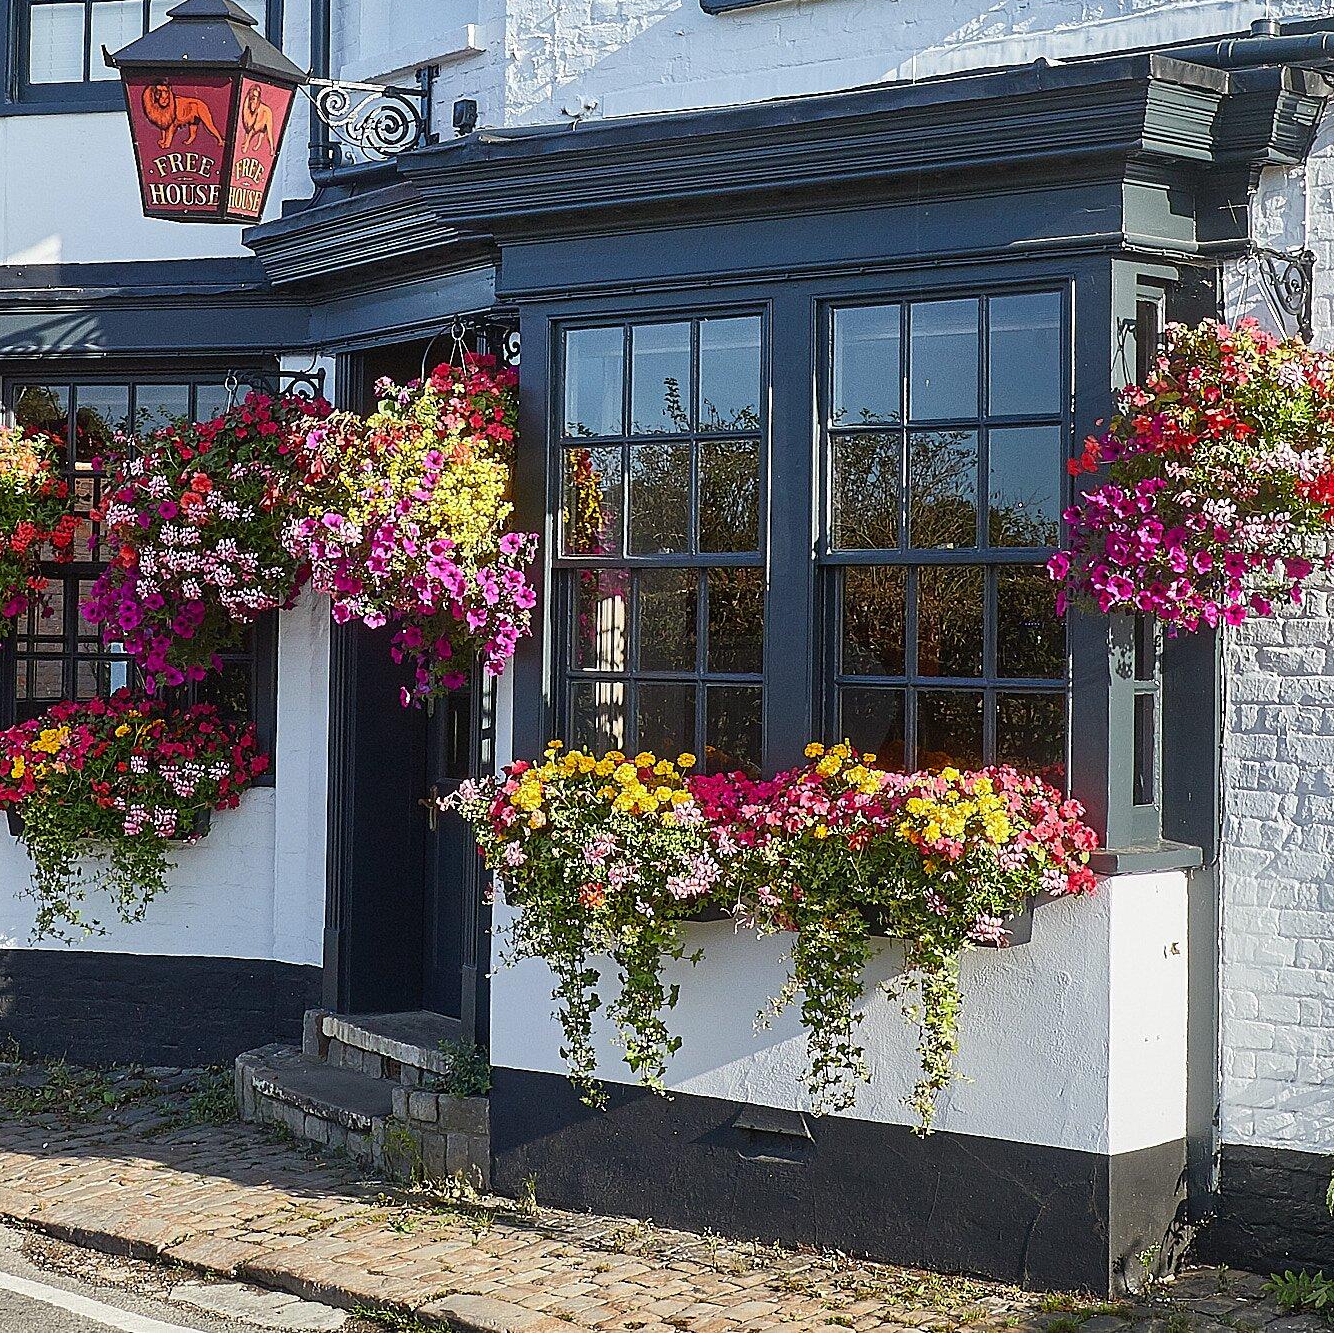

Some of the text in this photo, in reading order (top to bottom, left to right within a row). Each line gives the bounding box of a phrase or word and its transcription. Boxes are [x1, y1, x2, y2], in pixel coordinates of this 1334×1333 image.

[152, 152, 215, 178] FREE
[234, 157, 265, 184] FREE
[149, 183, 221, 206] HOUSE
[228, 186, 263, 212] HOUSE
